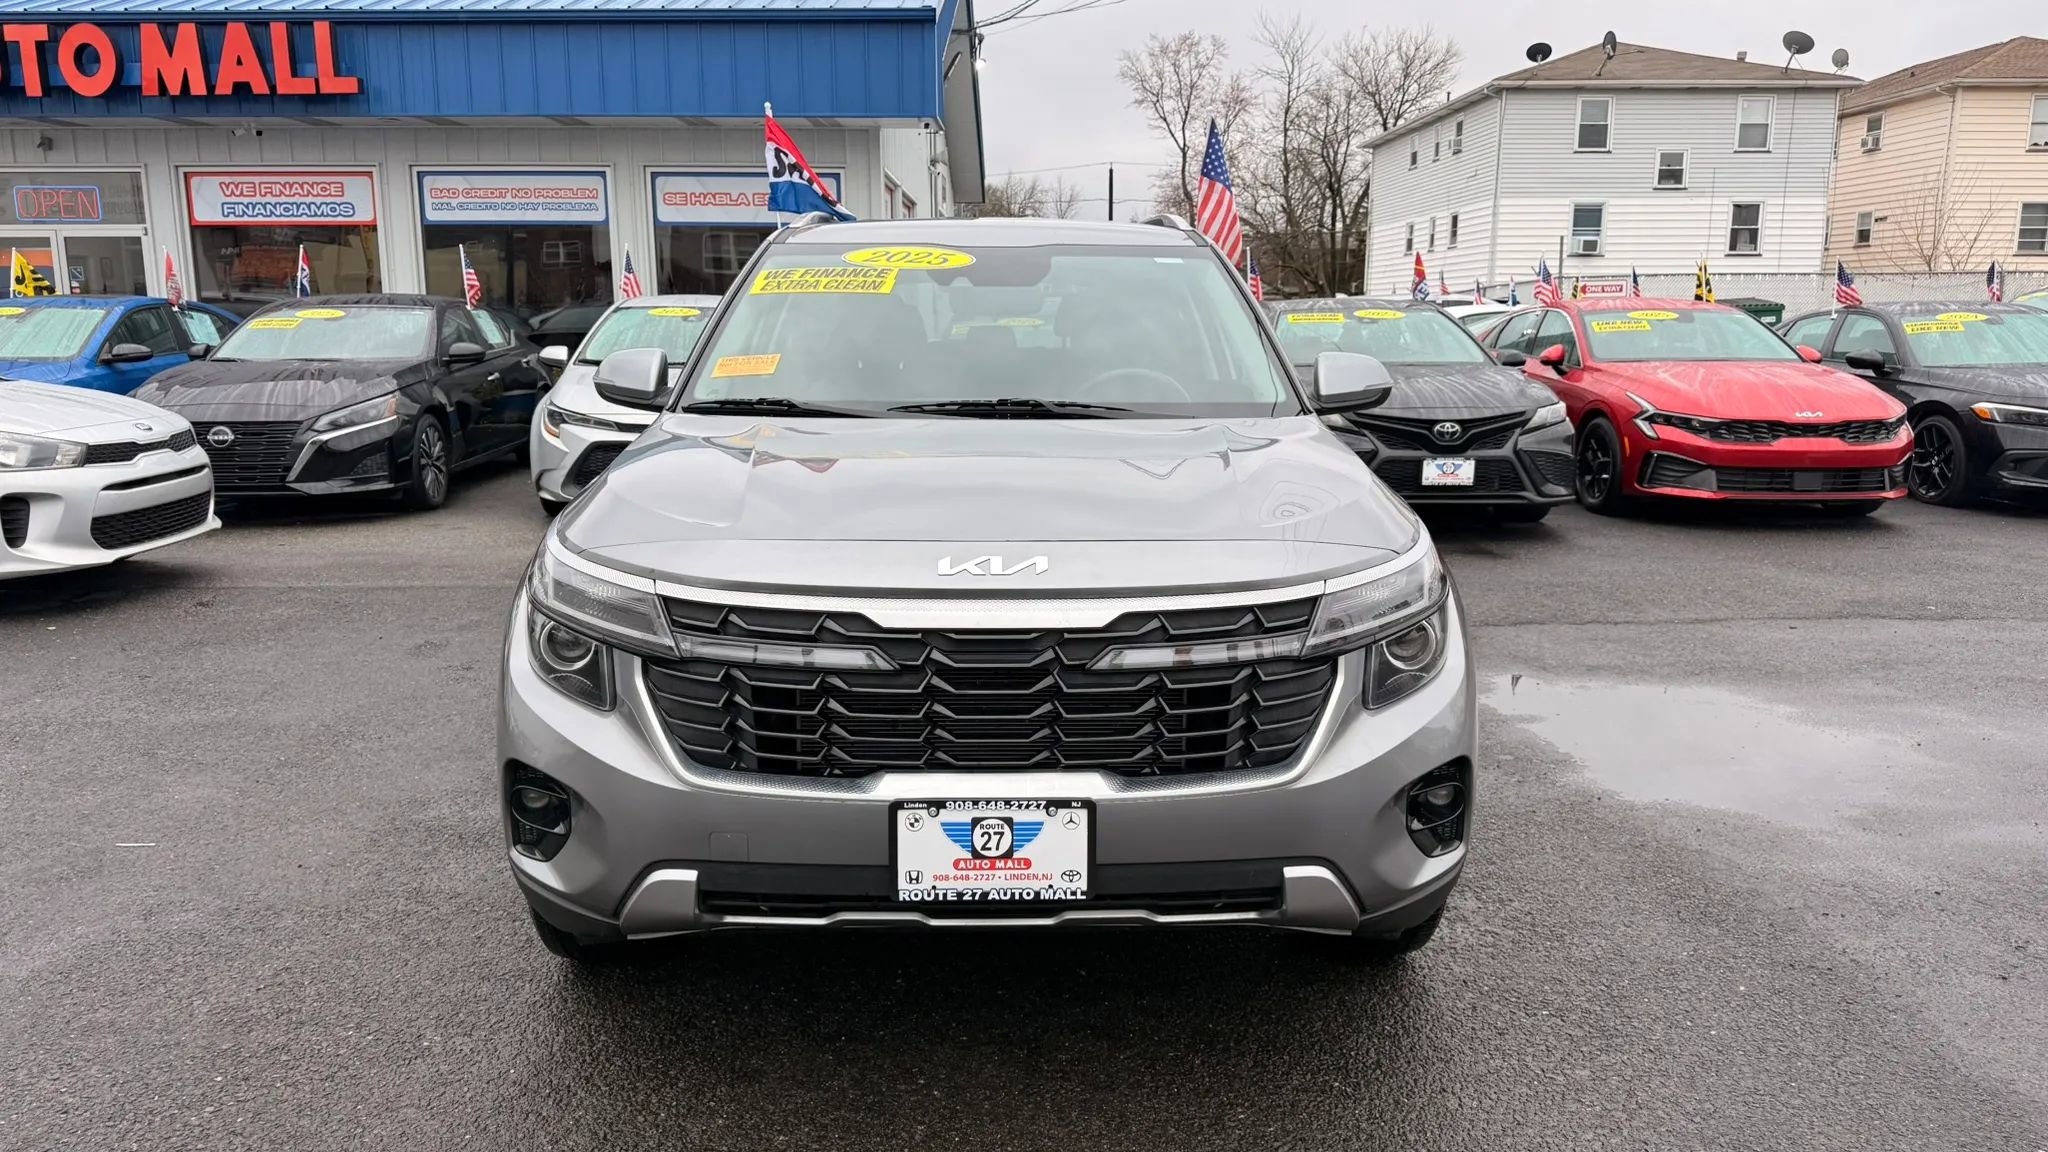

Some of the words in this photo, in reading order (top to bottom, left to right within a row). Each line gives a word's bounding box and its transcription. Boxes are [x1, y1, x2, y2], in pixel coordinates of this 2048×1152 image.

[0, 22, 116, 97] TO
[140, 21, 359, 96] MALL
[220, 182, 256, 197] WE
[257, 182, 344, 197] FINANCE
[431, 188, 459, 199] BAD
[462, 188, 508, 199] CREDIT
[511, 188, 532, 199] NO
[534, 188, 598, 199] PROBLEM
[17, 189, 99, 218] OPEN
[663, 192, 687, 206] SE
[687, 192, 750, 206] HABLA
[222, 202, 355, 218] FINANCIAMOS
[432, 202, 456, 211] MAL
[457, 202, 499, 211] CREDITO
[501, 202, 517, 211] NO
[518, 202, 540, 211] HAY
[542, 202, 598, 211] PROBLEMA
[862, 251, 955, 266] 2025
[763, 270, 798, 281] WE
[798, 268, 891, 280] FINANCE
[759, 280, 821, 292] EXTRA
[822, 279, 887, 291] CLEAN
[937, 556, 1049, 576] KIA
[945, 800, 1047, 812] 908-648-2727
[979, 831, 1005, 851] 27
[957, 860, 990, 870] AUTO
[994, 860, 1028, 870] MALL
[932, 873, 996, 882] 908-648-2727
[1004, 872, 1053, 882] LINDEN,NJ
[898, 889, 957, 901] ROUTE
[962, 889, 983, 900] 27
[987, 889, 1034, 900] AUTO
[1039, 888, 1087, 900] MALL
